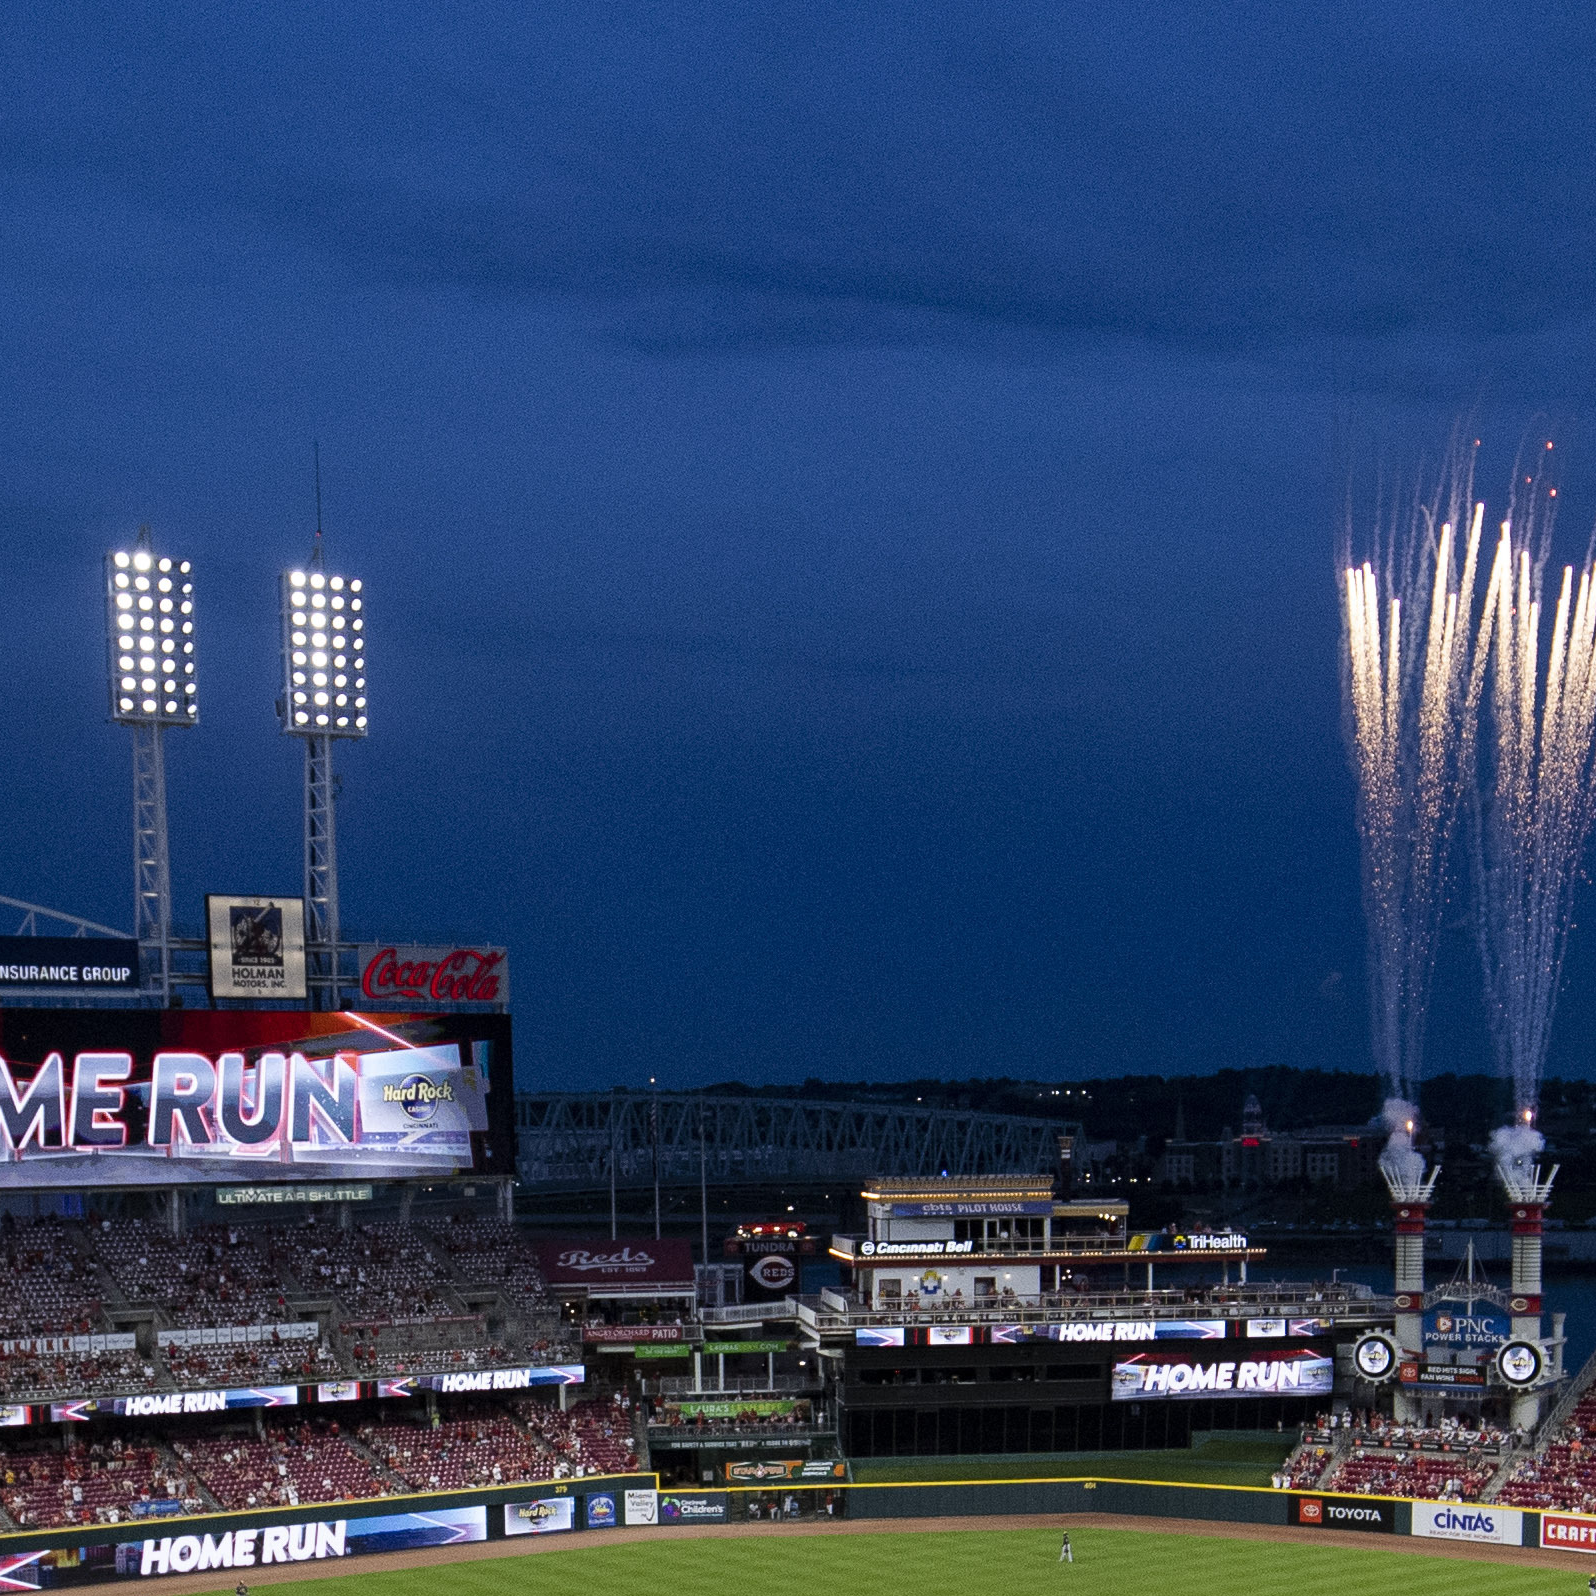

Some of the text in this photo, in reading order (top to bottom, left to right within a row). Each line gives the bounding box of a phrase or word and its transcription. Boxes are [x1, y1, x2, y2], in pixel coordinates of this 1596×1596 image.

[81, 966, 132, 983] GROUP
[231, 967, 285, 980] HOLMAN
[361, 947, 506, 1001] Coca-Cola
[383, 1081, 455, 1104] Hard Rock
[147, 1050, 361, 1155] RUN
[217, 1190, 284, 1205] ULTIMATE
[308, 1189, 370, 1203] SHUTTLE
[957, 1202, 987, 1215] PILOT
[989, 1201, 1025, 1213] HOUSE
[743, 1241, 795, 1253] TUNDRA
[875, 1239, 973, 1256] Cincinnati Bell
[1186, 1233, 1247, 1250] TriHealth
[556, 1247, 656, 1271] Reds
[761, 1267, 796, 1278] REDS
[1058, 1321, 1157, 1343] HOME RUN
[1454, 1316, 1495, 1334] PNC
[651, 1328, 678, 1340] PATIO
[1425, 1331, 1505, 1344] POWER STACKS
[441, 1369, 530, 1393] HOME RUN
[1143, 1362, 1236, 1392] HOME
[1236, 1360, 1302, 1389] RUN
[124, 1391, 226, 1417] HOME RUN
[626, 1492, 654, 1501] Miami
[629, 1499, 655, 1509] Valley
[518, 1507, 538, 1519] Hard
[681, 1504, 725, 1515] Children's
[1327, 1506, 1382, 1522] TOYOTA
[140, 1519, 347, 1576] HOME RUN
